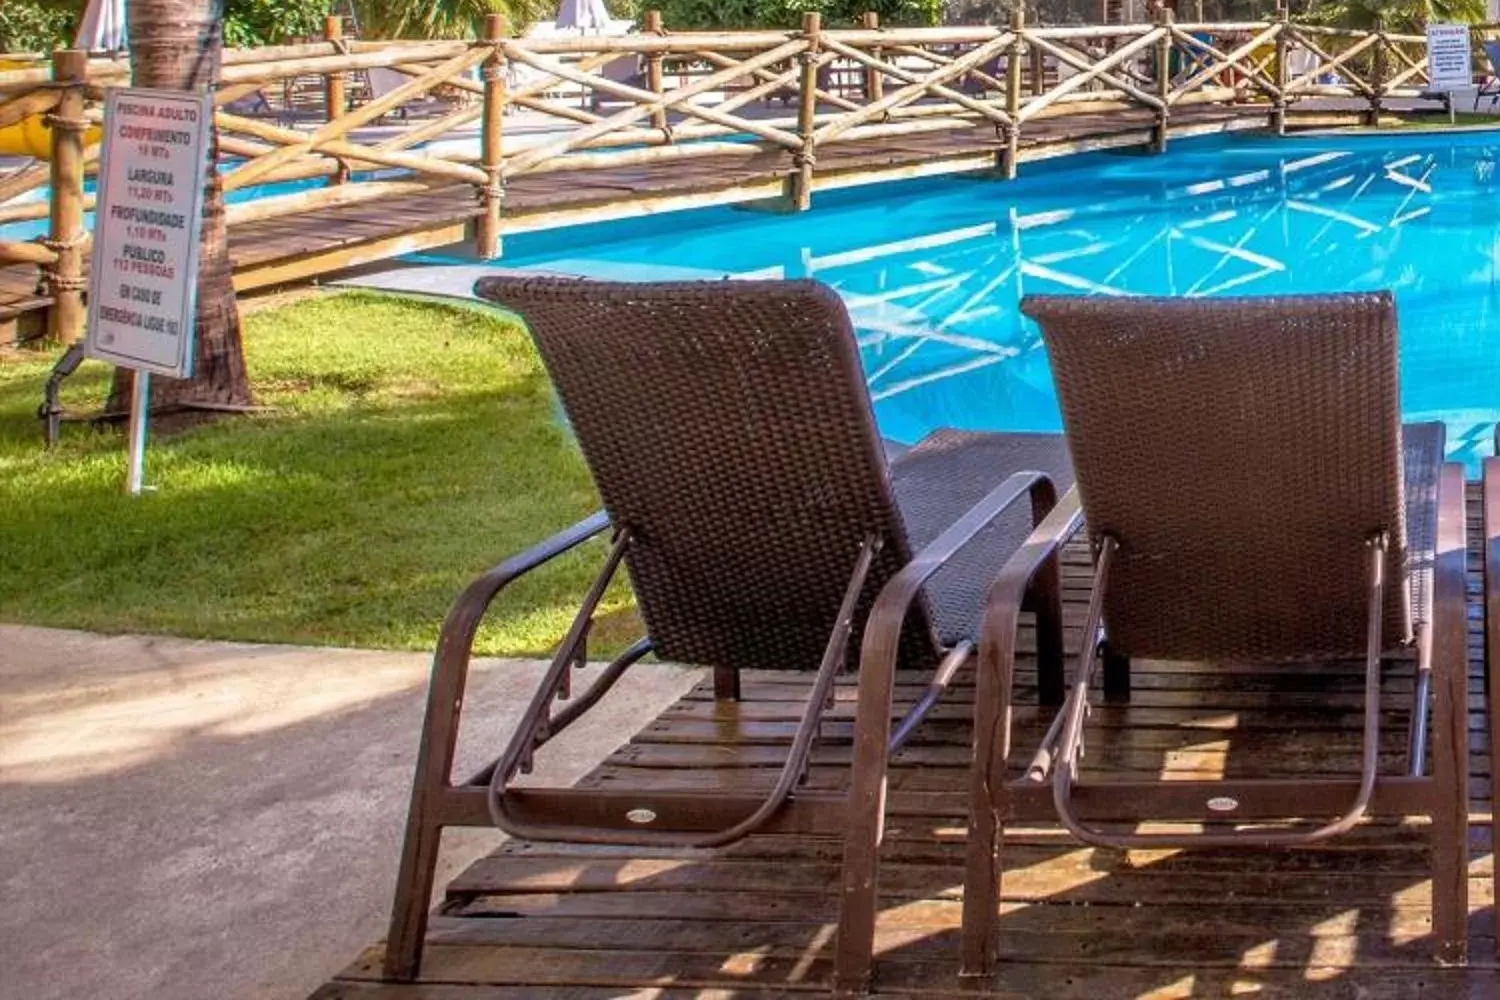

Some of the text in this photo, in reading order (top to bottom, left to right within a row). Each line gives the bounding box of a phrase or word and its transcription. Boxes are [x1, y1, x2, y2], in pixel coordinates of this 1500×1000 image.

[157, 106, 197, 122] ADULTO
[127, 166, 174, 186] LARGURA
[111, 205, 185, 229] PROFUNDIDADE
[131, 261, 175, 279] PESSOAS
